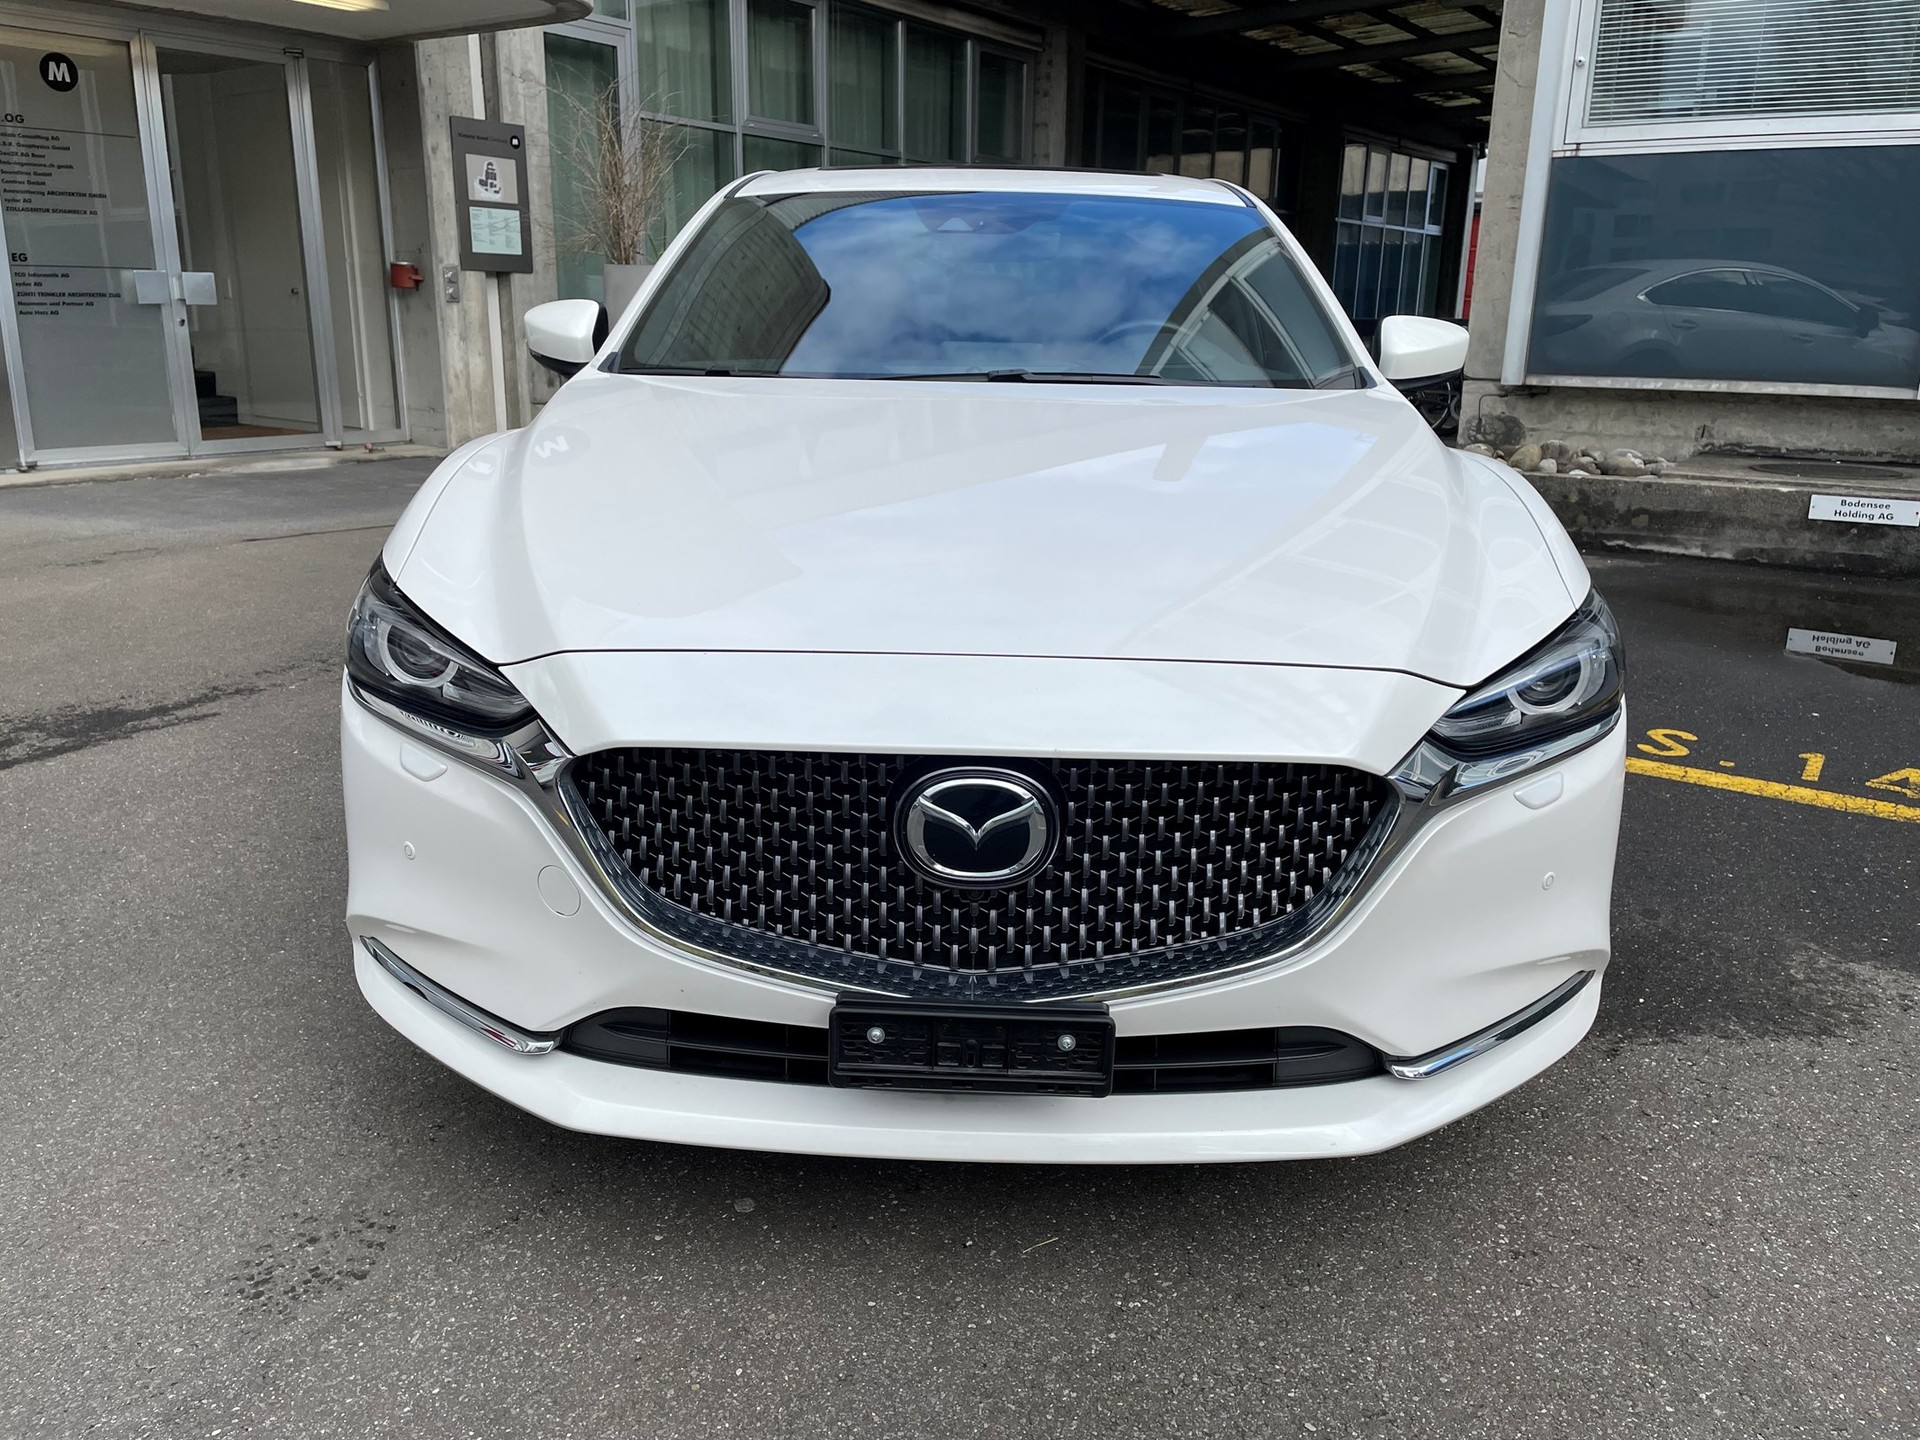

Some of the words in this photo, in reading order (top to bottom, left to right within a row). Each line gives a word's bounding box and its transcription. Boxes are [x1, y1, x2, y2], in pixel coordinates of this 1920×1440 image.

[48, 61, 71, 82] M
[11, 253, 28, 262] EG
[1840, 499, 1891, 510] Bodensee
[1834, 510, 1875, 521] Holding
[1878, 513, 1894, 521] AG
